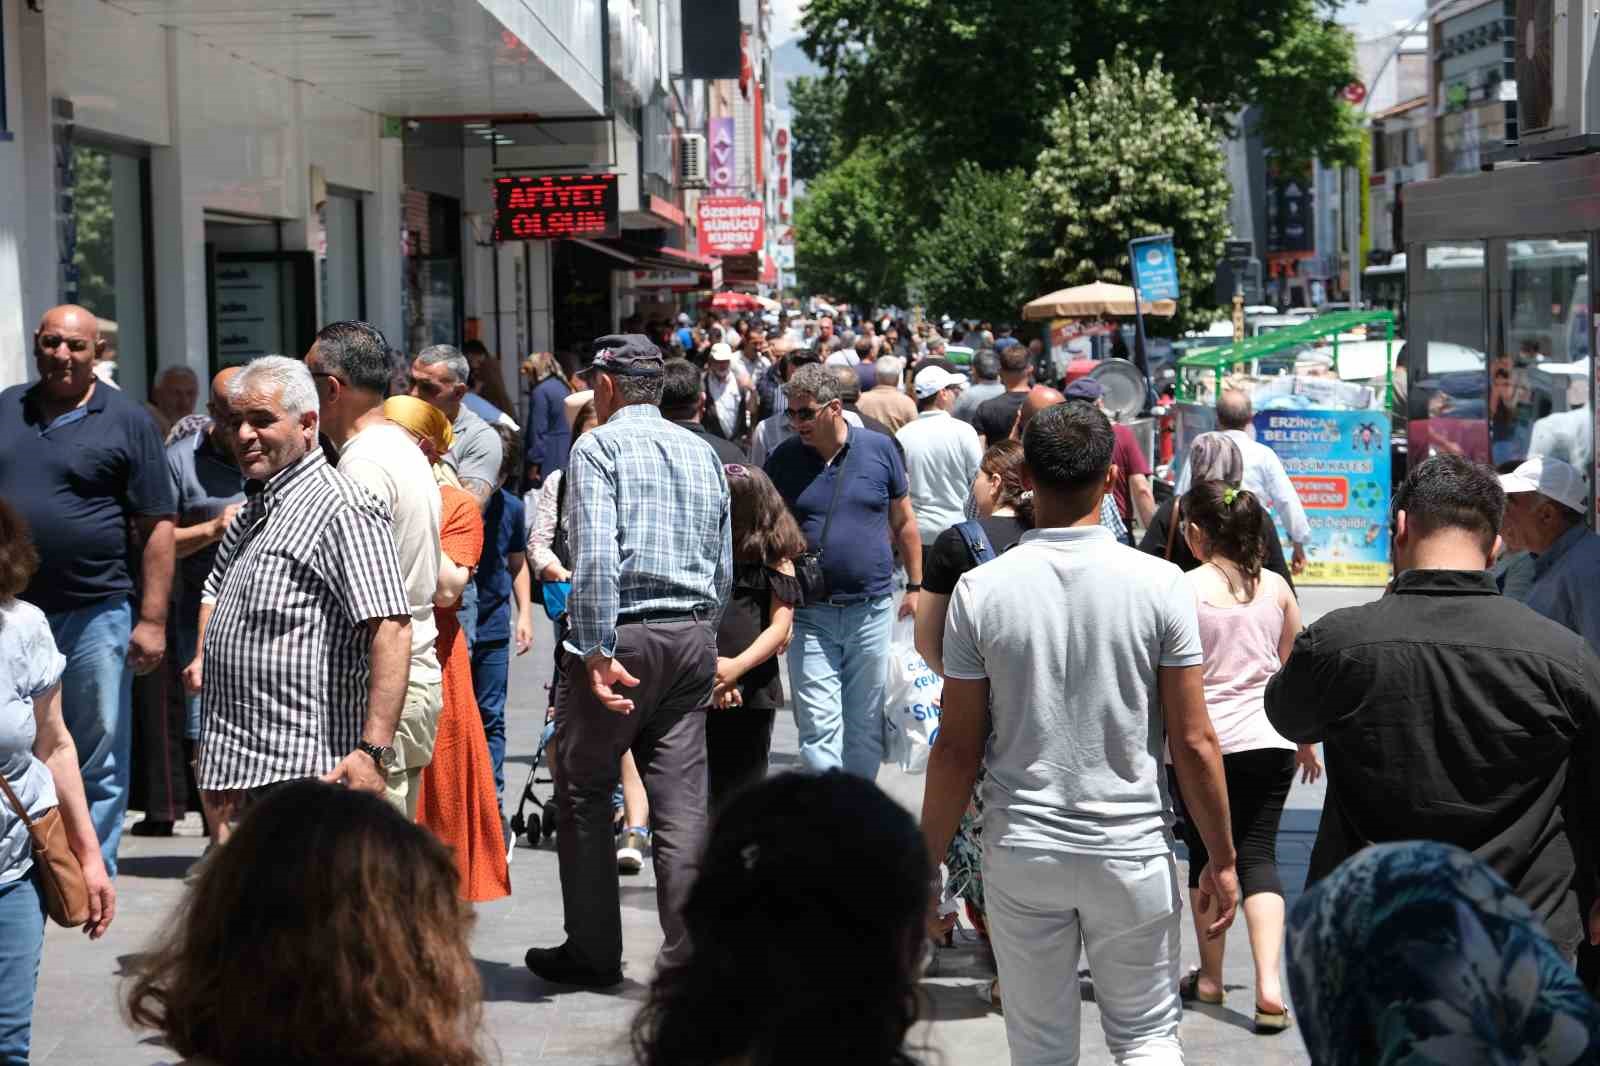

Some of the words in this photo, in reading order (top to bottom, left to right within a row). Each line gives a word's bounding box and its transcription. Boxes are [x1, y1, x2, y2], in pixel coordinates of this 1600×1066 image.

[714, 128, 732, 198] AVON
[776, 128, 789, 222] OTEL
[508, 181, 608, 208] AFİYET
[511, 211, 606, 235] OLSUN
[703, 217, 759, 231] SÜRÜCÜ
[707, 231, 754, 243] KURSU
